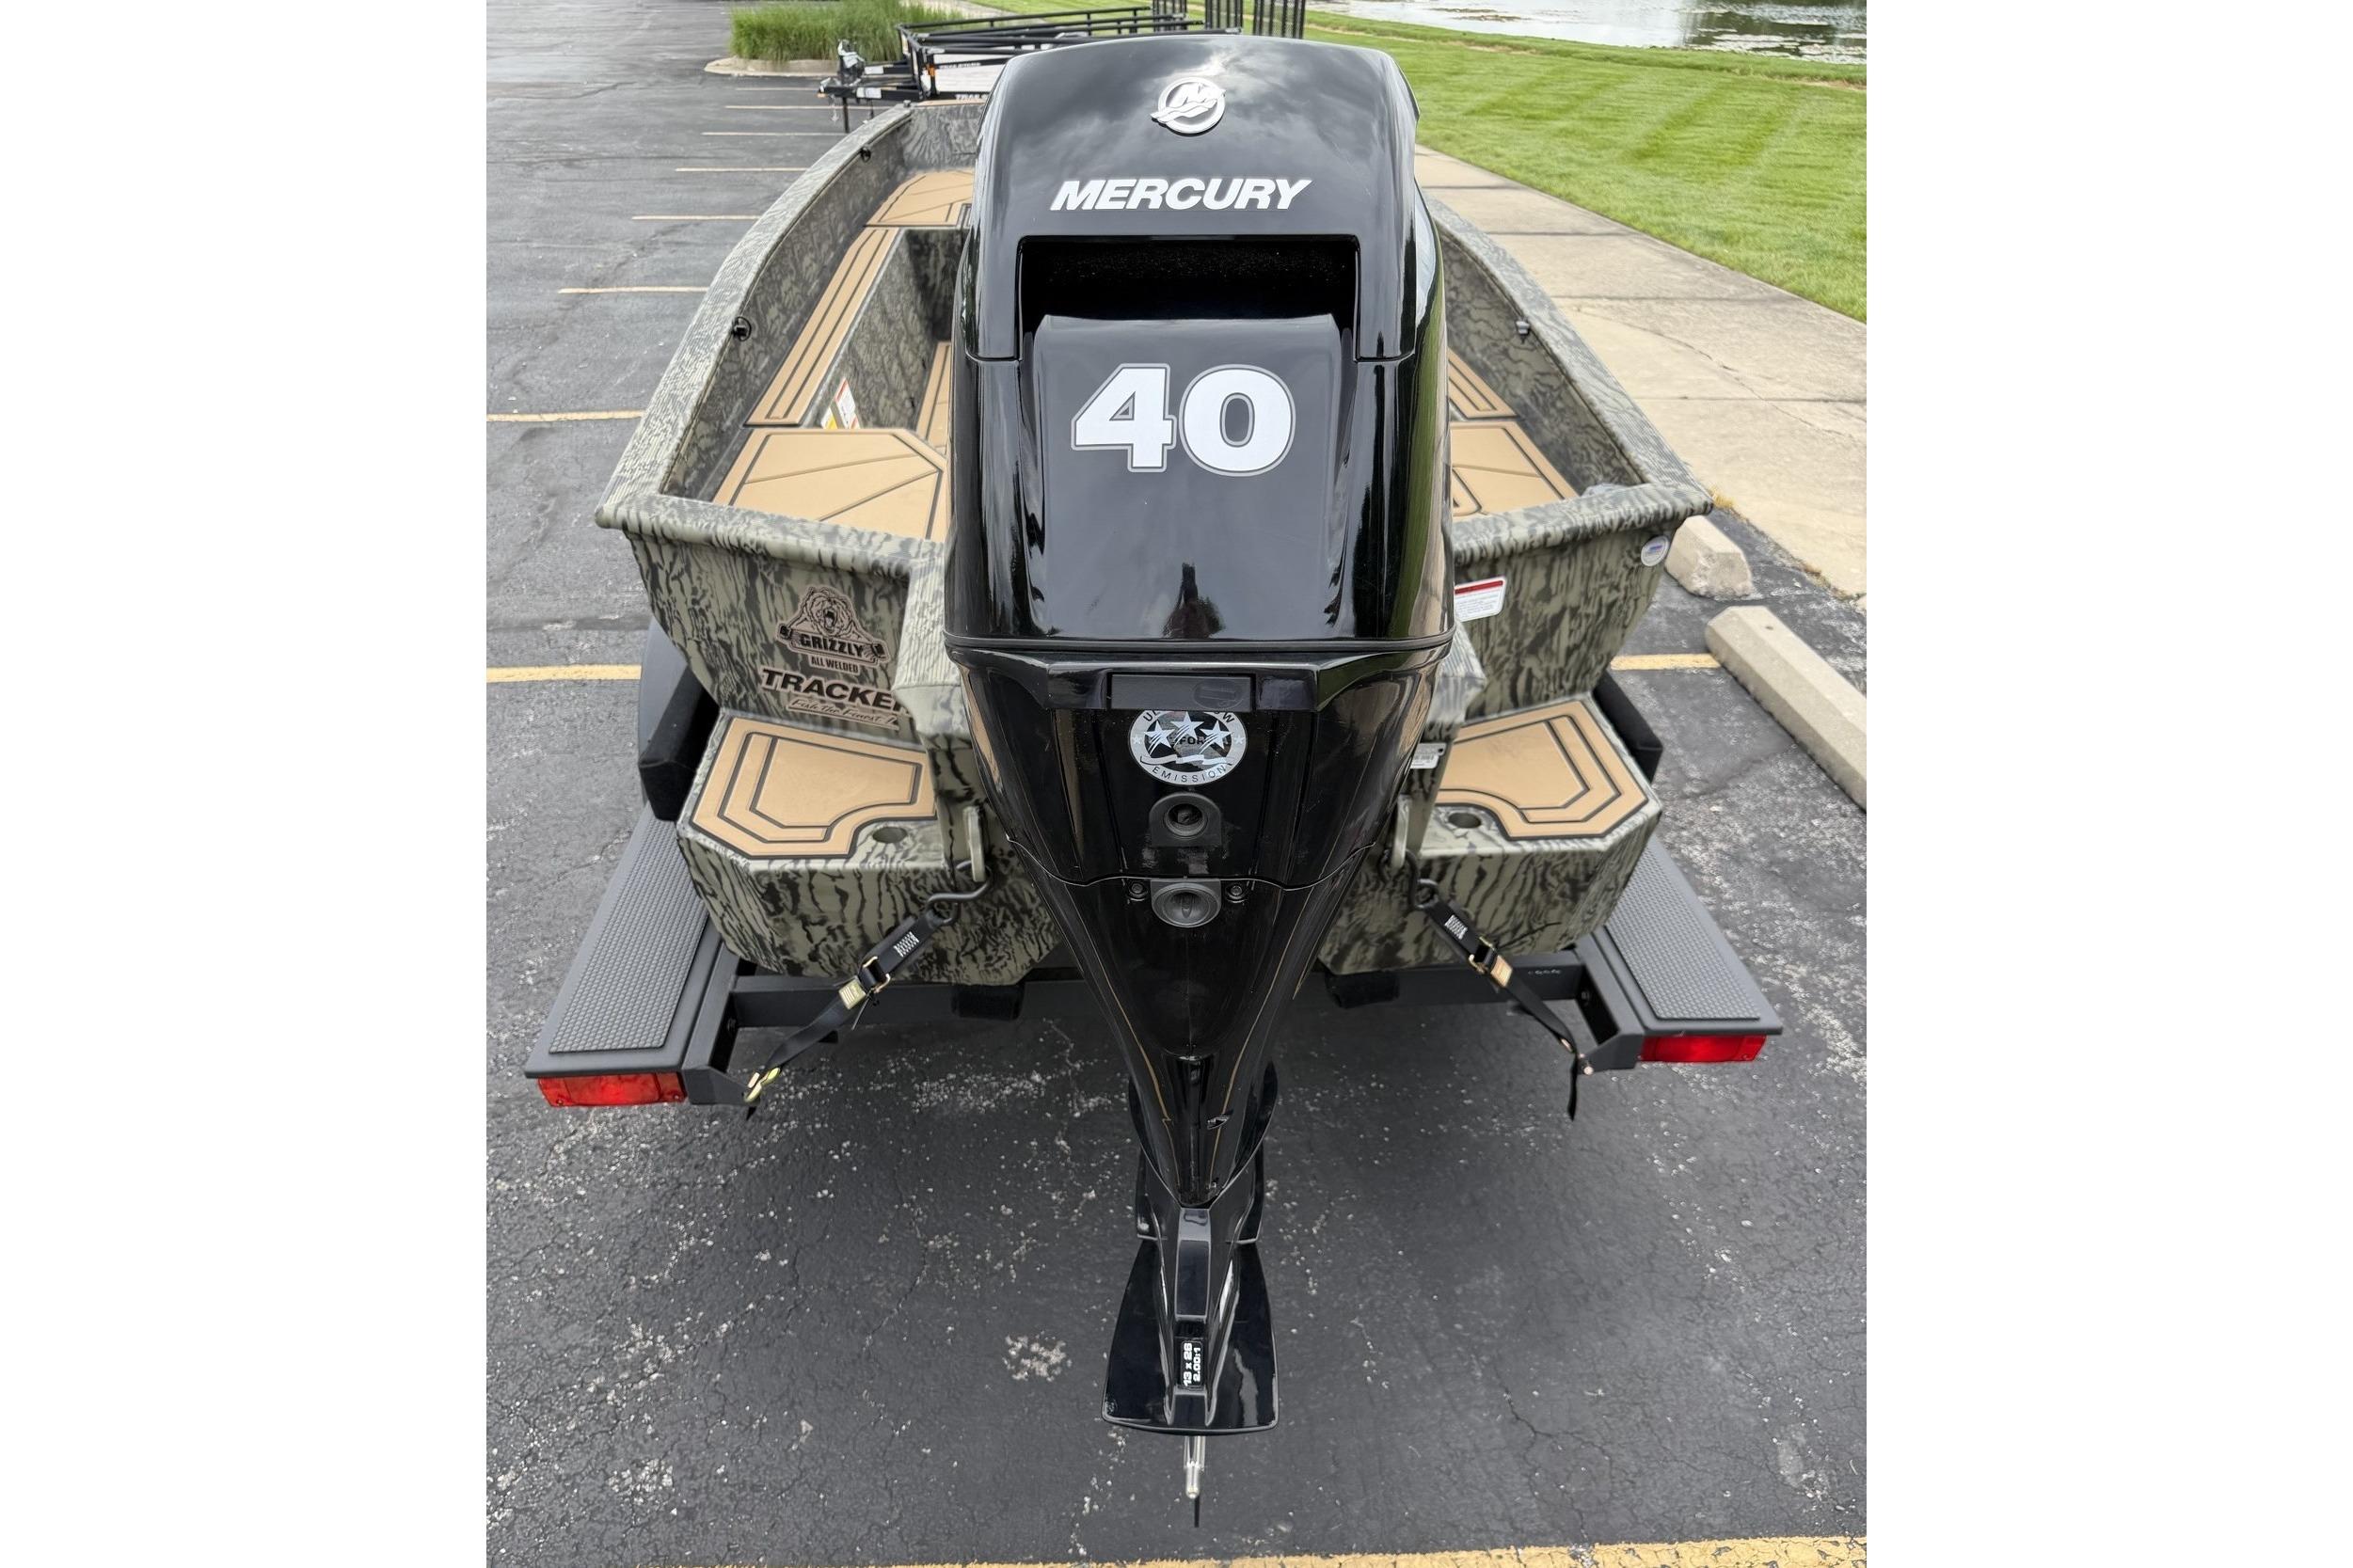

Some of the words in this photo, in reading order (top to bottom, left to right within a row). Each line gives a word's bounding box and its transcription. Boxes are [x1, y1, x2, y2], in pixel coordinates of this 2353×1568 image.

[1050, 178, 1312, 211] MERCURY
[1071, 363, 1296, 477] 40
[800, 634, 865, 657] GRIZZLY
[811, 657, 825, 669] ALL
[825, 658, 859, 673] WELDED
[1152, 765, 1227, 783] EMISSION
[1184, 1371, 1192, 1386] 13
